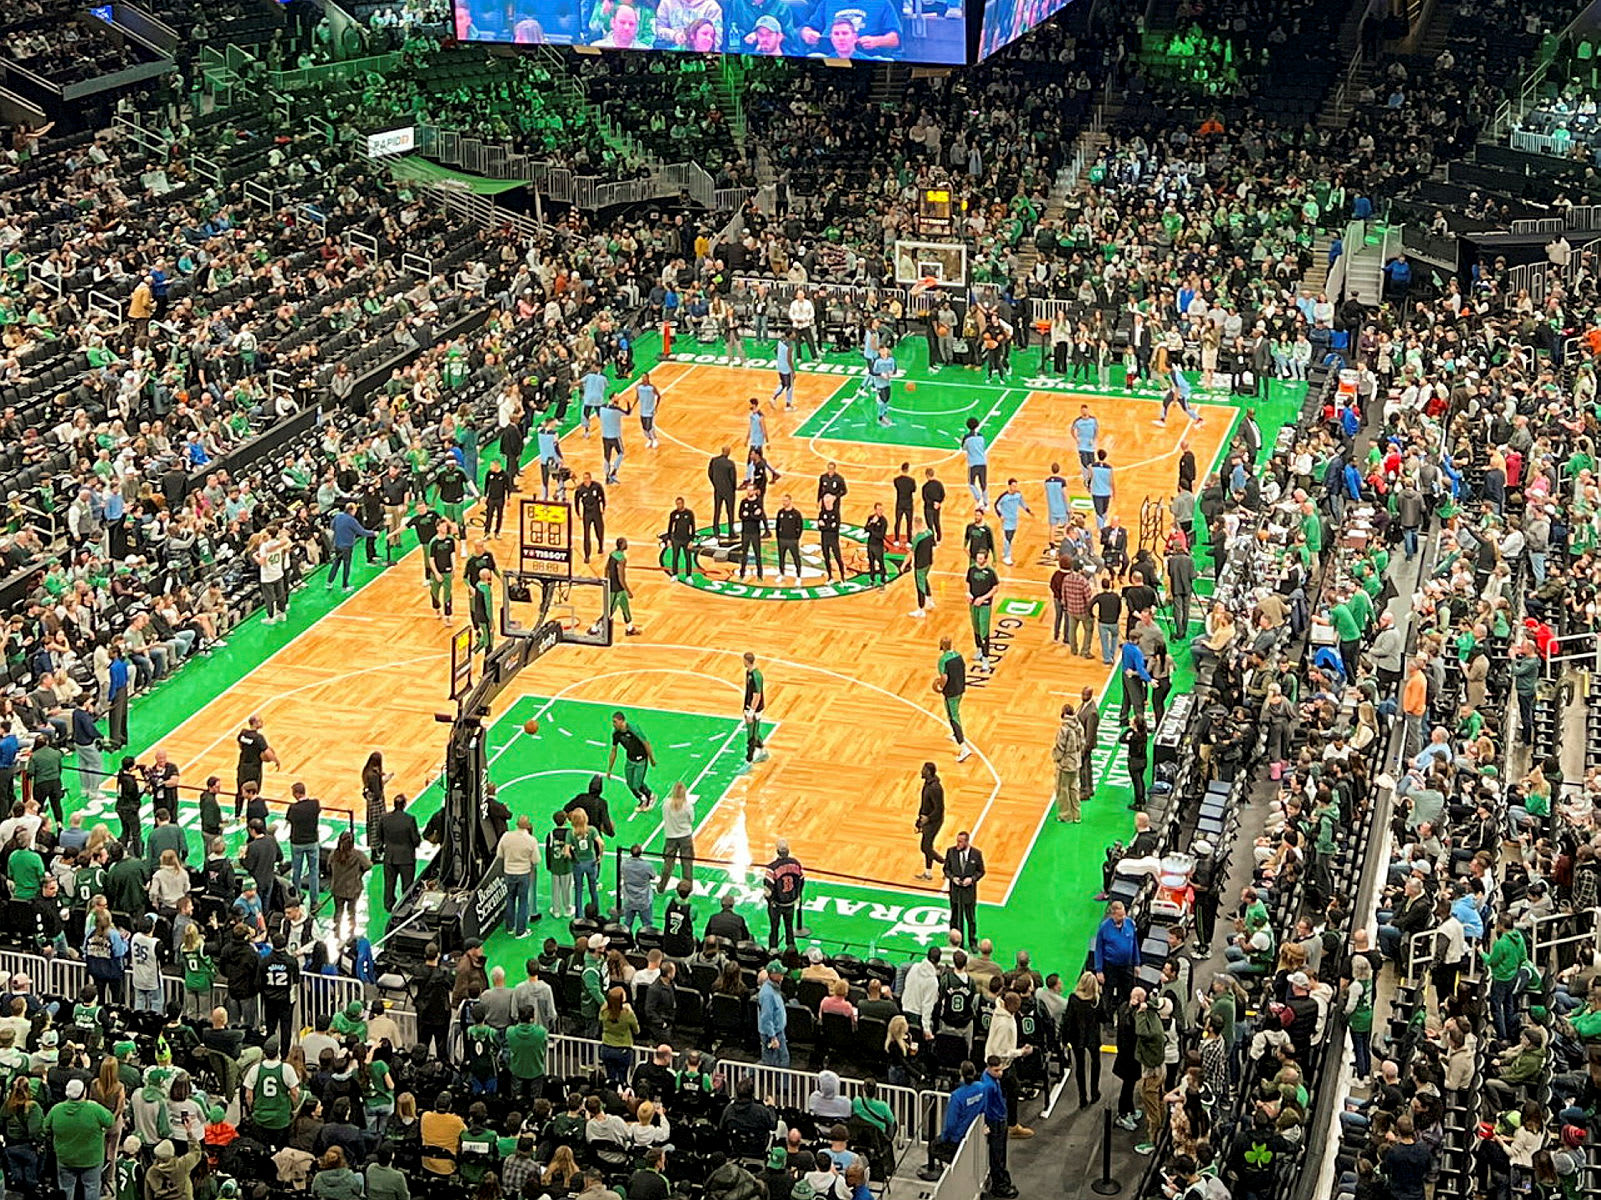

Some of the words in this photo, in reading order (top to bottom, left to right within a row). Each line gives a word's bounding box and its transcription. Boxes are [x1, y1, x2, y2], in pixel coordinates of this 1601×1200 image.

[799, 362, 908, 377] CELTIS
[80, 886, 91, 900] 0
[669, 919, 681, 935] 7
[266, 972, 288, 986] 12
[1022, 1017, 1035, 1035] 0
[262, 1079, 277, 1097] 6
